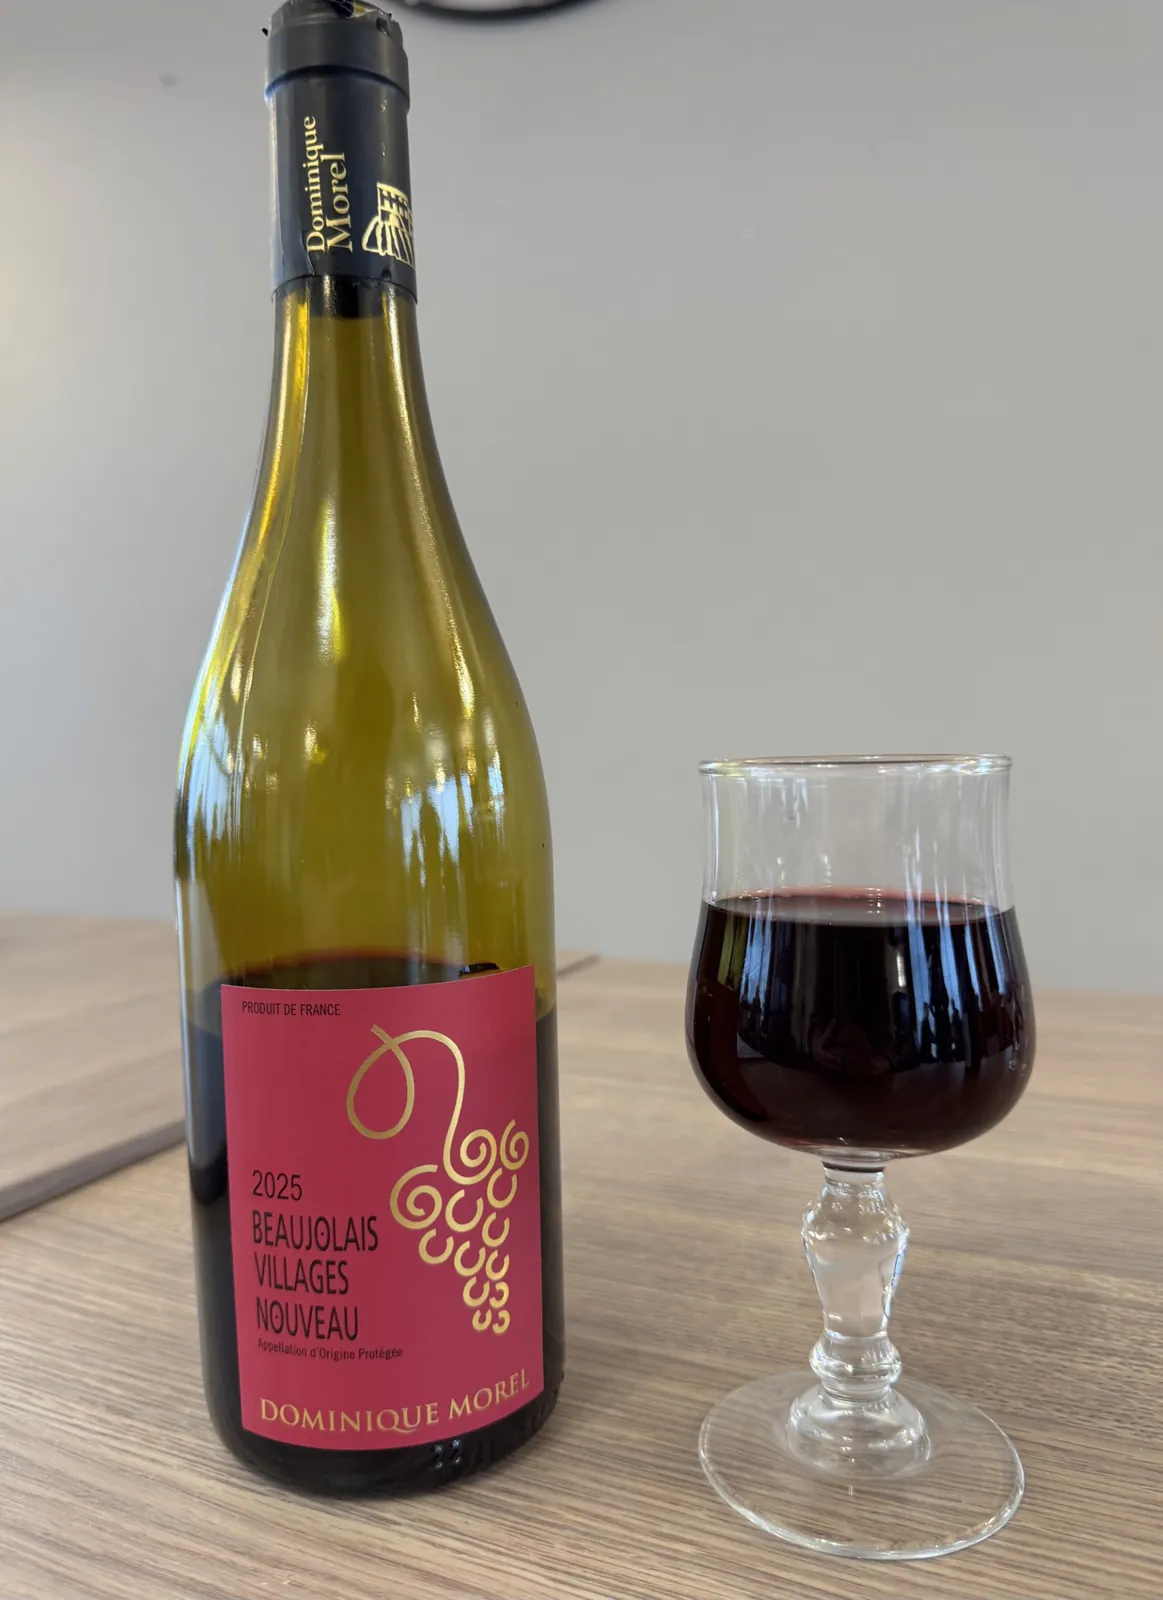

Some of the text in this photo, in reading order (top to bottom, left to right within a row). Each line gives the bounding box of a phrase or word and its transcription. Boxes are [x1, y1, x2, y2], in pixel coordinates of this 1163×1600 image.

[303, 115, 326, 253] Dominique
[320, 152, 353, 253] Morel
[241, 1000, 341, 1016] PRODUIT DE FRANCE
[252, 1170, 303, 1201] 2025
[252, 1209, 379, 1252] BEAUJOLAIS
[254, 1251, 350, 1295] VILLAGES
[256, 1296, 359, 1341] NOUVEAU
[257, 1337, 403, 1362] Appellation d'Origine Protégée
[260, 1367, 530, 1434] DOMINIQUE MOREL
